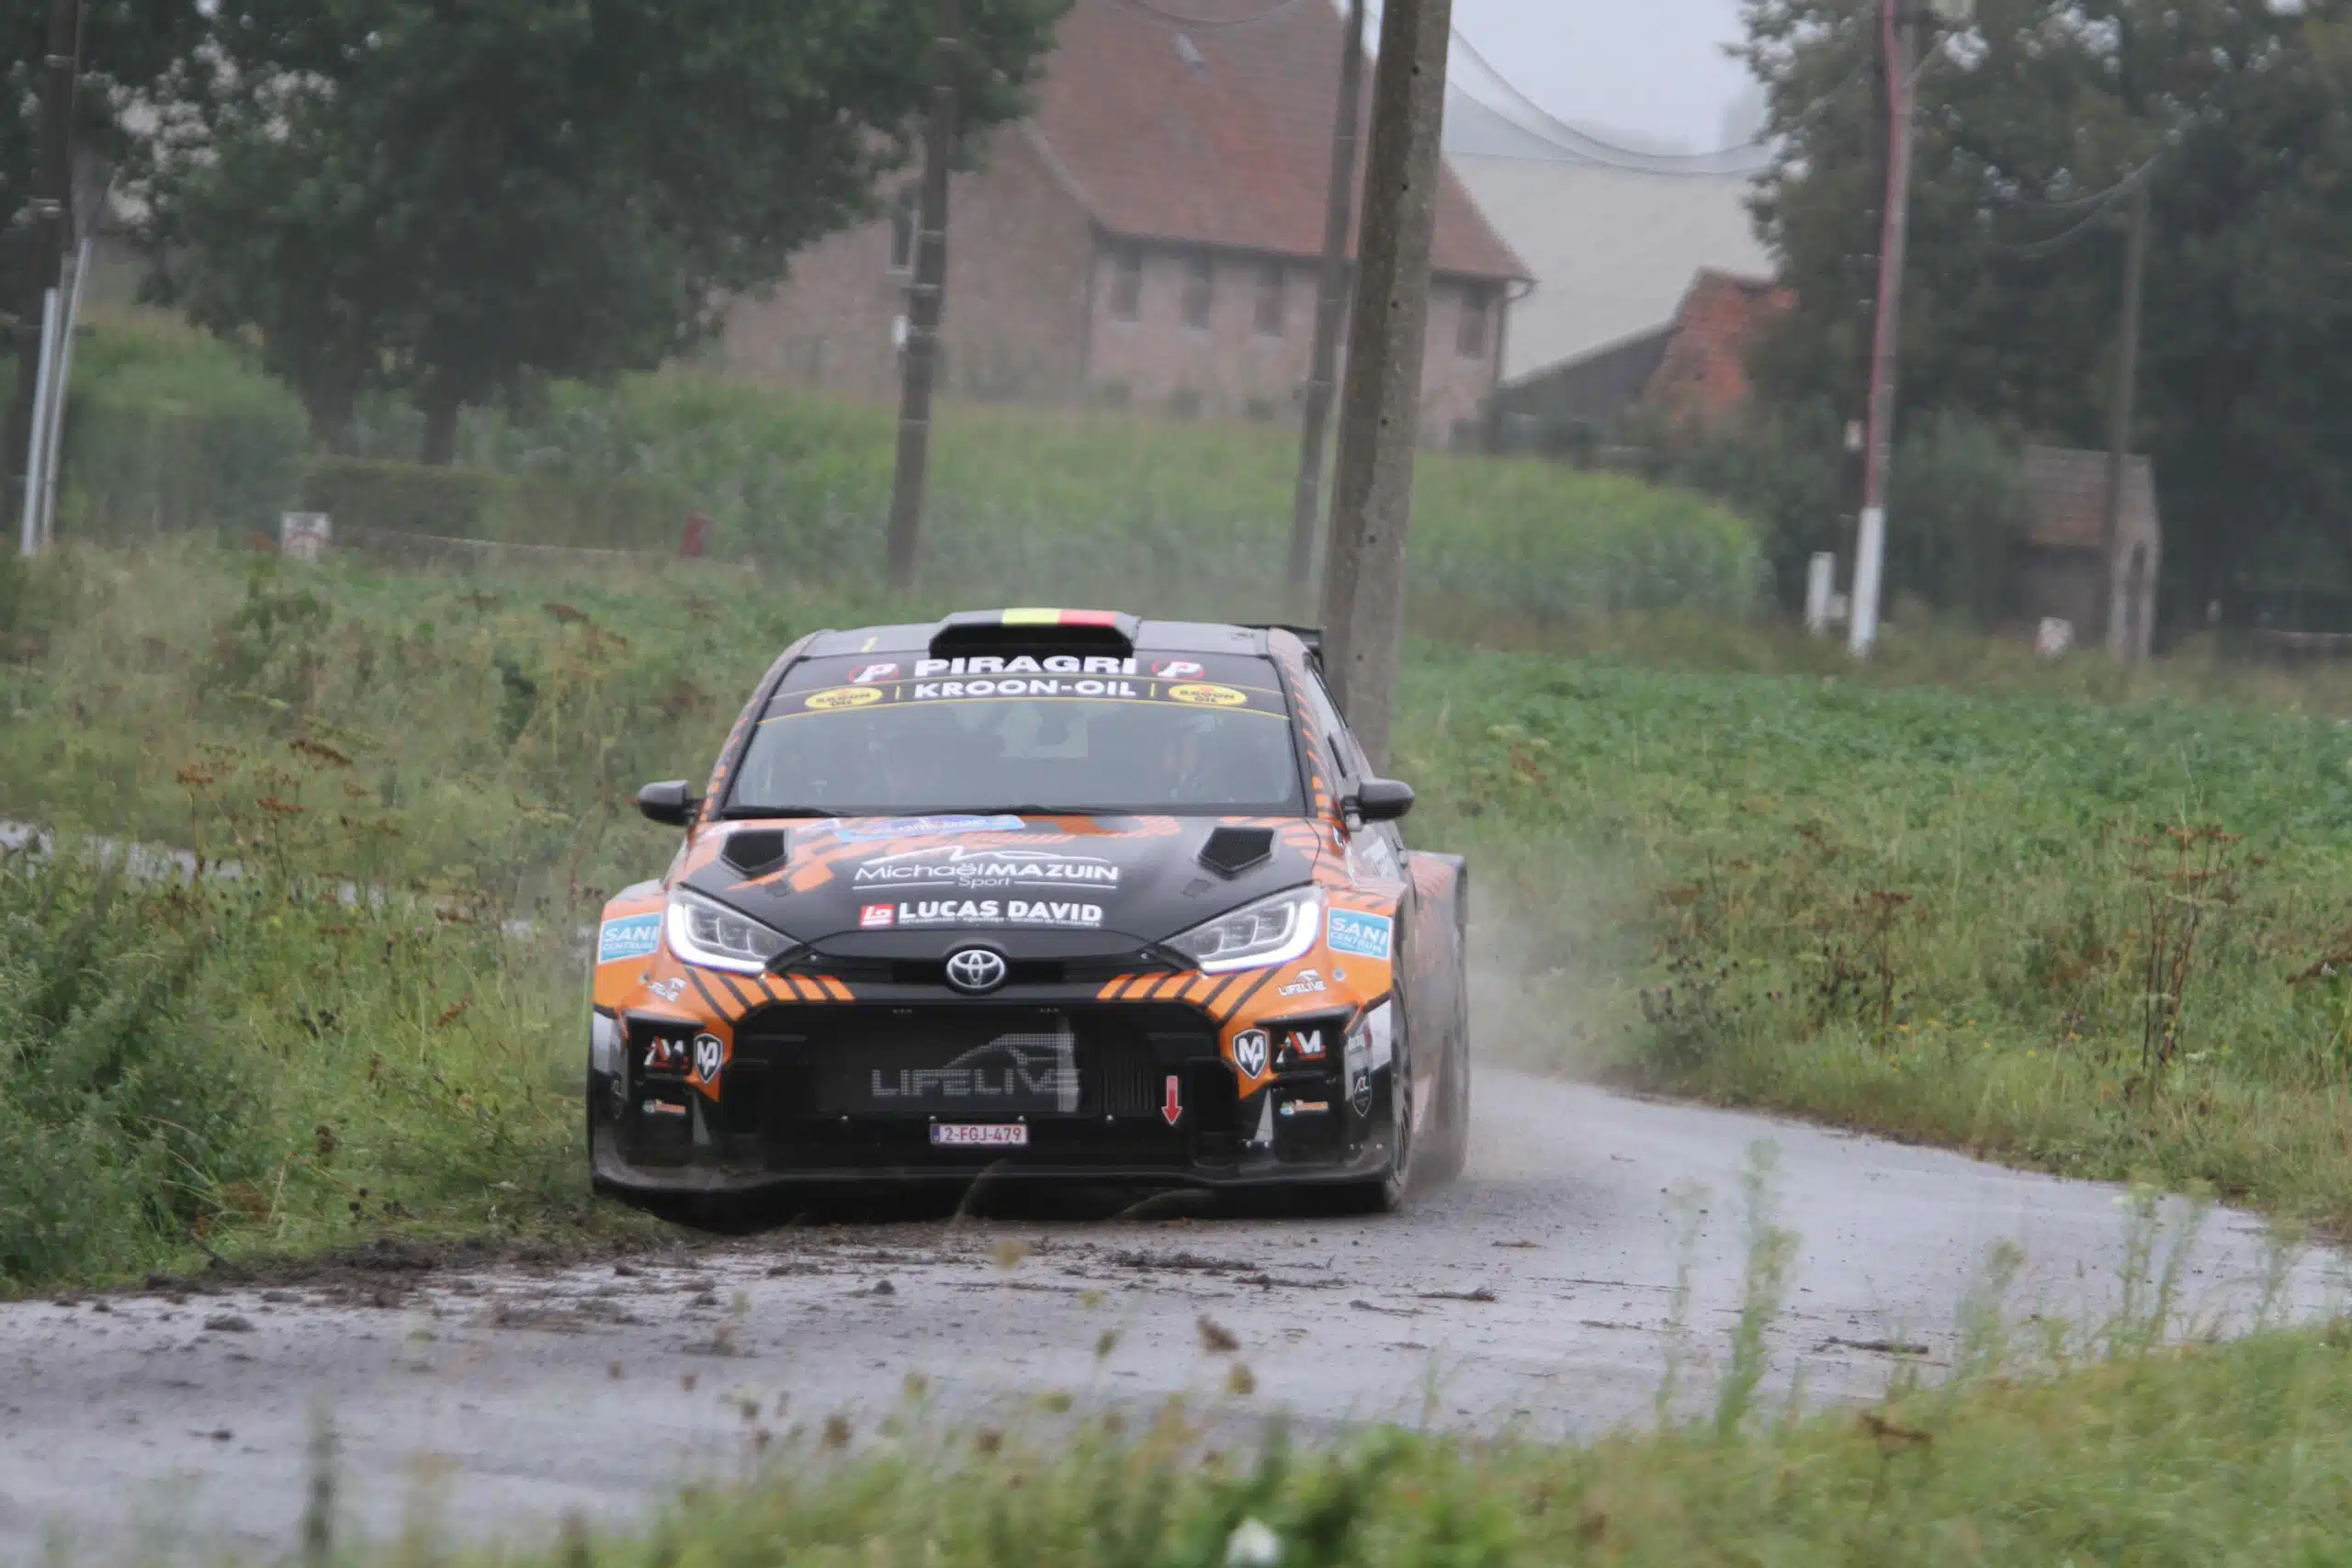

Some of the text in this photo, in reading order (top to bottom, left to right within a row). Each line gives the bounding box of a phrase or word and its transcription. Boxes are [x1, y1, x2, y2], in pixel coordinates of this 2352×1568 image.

[915, 655, 1137, 678] PIRAGRI
[915, 679, 1136, 699] KROON-OIL
[958, 876, 1010, 889] Sport
[898, 900, 999, 919] LUCAS
[1008, 900, 1103, 922] DAVID
[603, 926, 659, 942] SANI
[1331, 918, 1387, 945] SANI
[944, 1126, 1023, 1142] 2-FGJ-479
